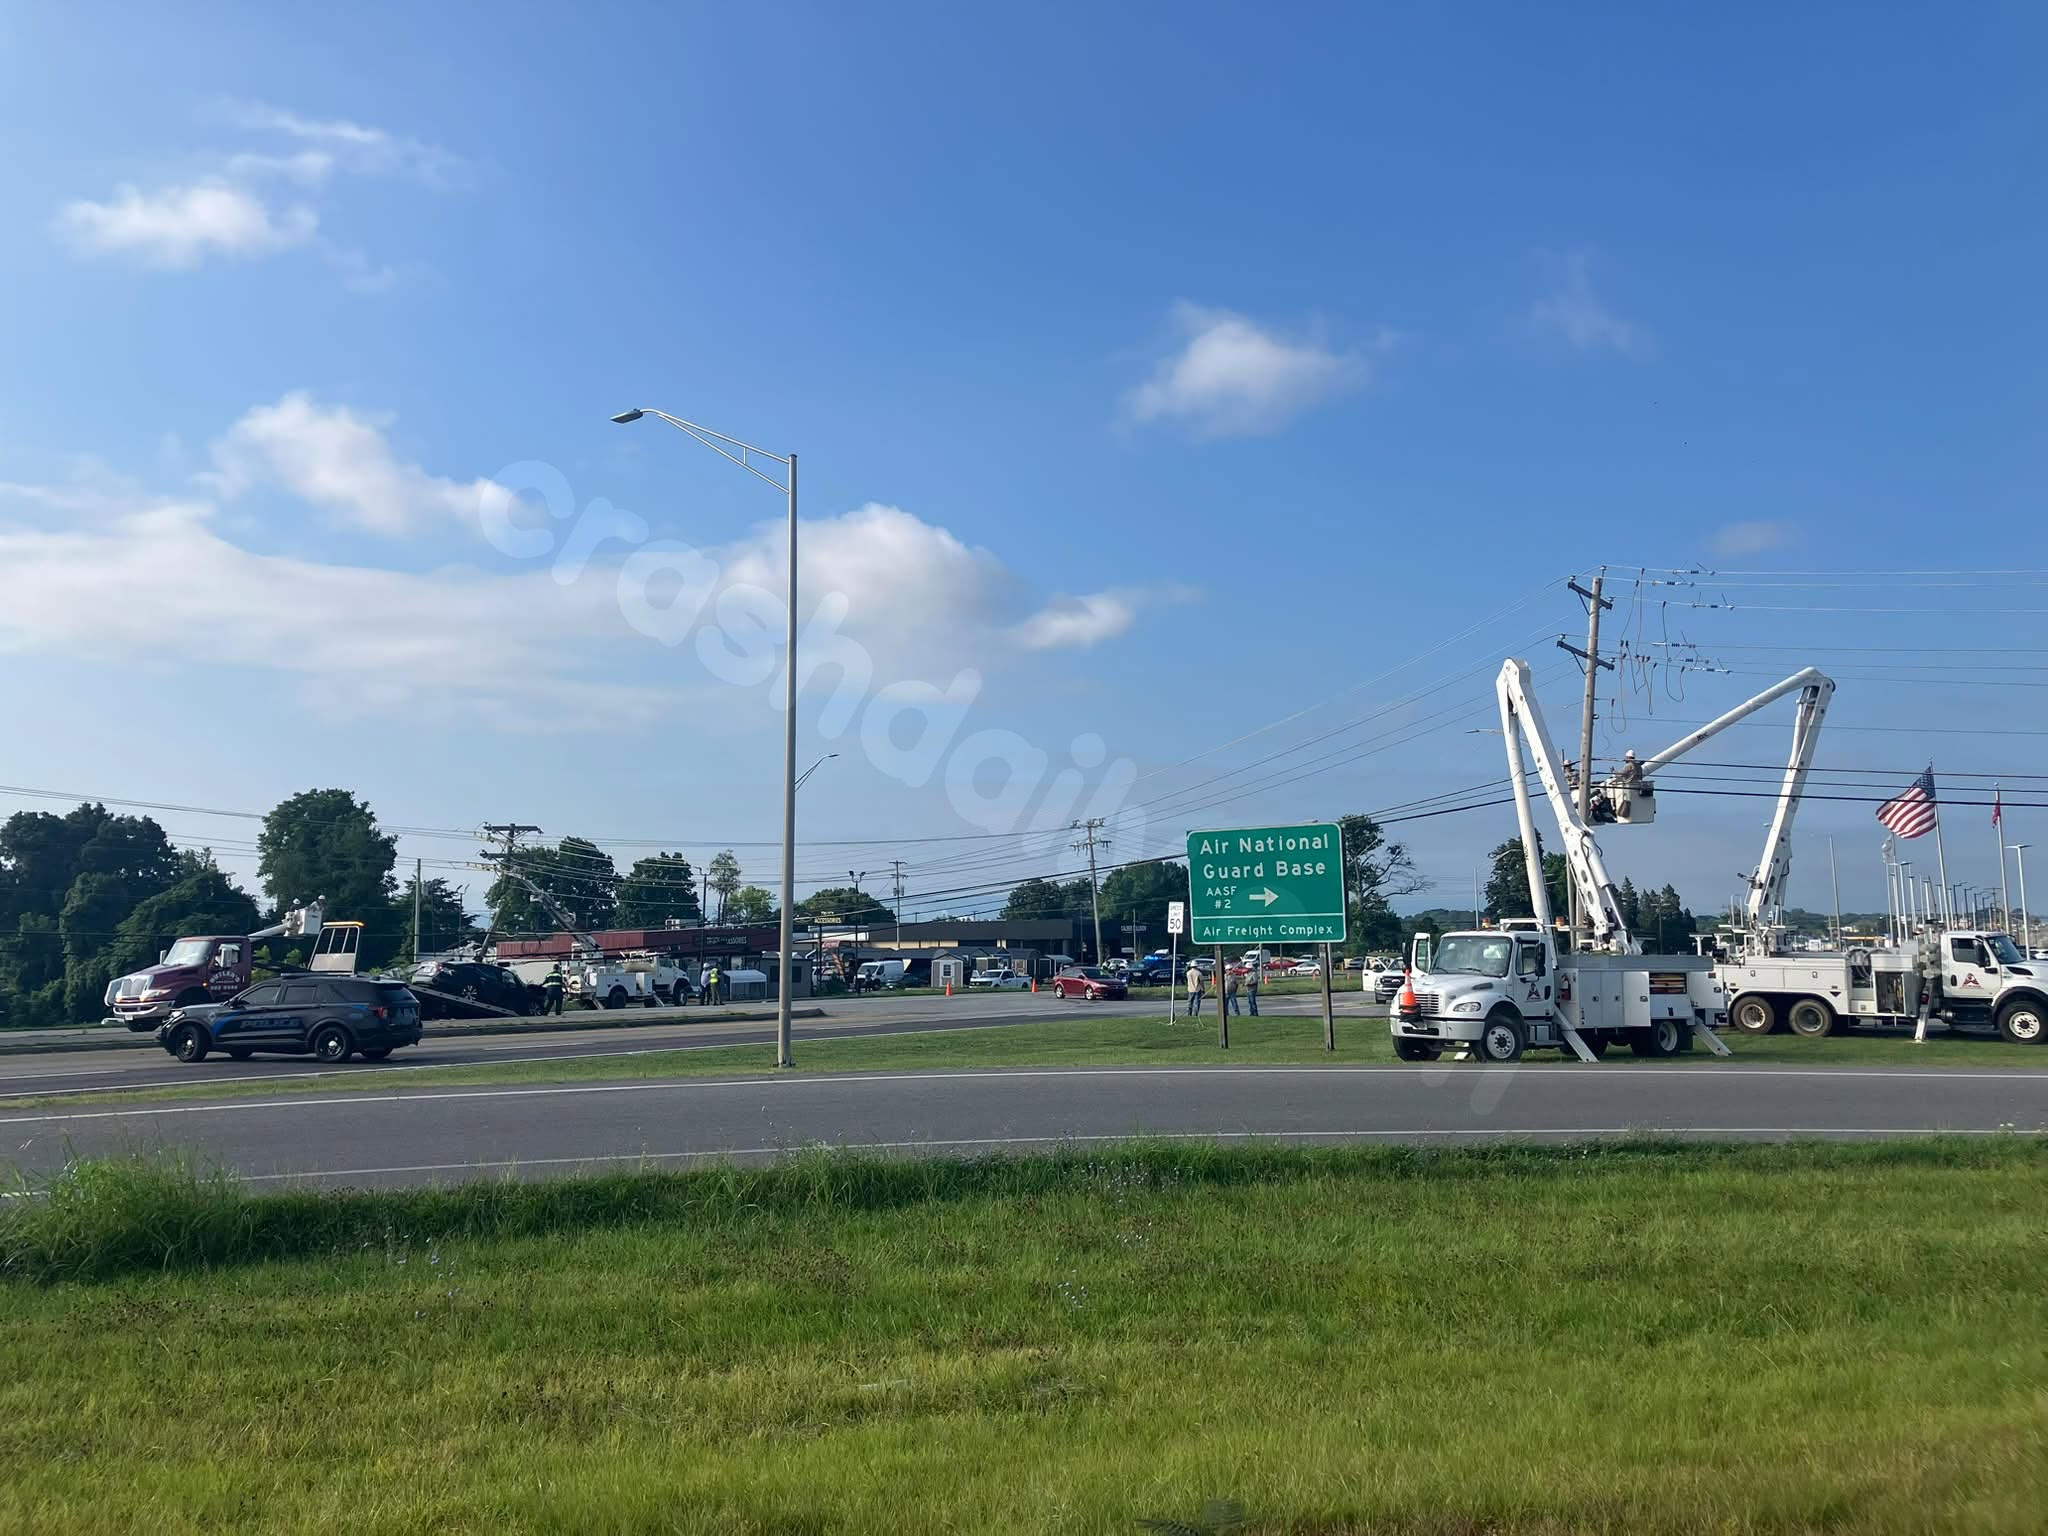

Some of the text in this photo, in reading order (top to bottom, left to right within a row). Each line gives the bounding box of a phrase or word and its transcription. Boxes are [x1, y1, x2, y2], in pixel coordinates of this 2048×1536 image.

[1200, 833, 1329, 855] Air National
[1203, 860, 1326, 879] Guard Base
[1206, 885, 1237, 897] AASF
[1214, 899, 1232, 909] #2
[1169, 918, 1182, 930] 50
[1203, 924, 1333, 938] Air Freight Complex
